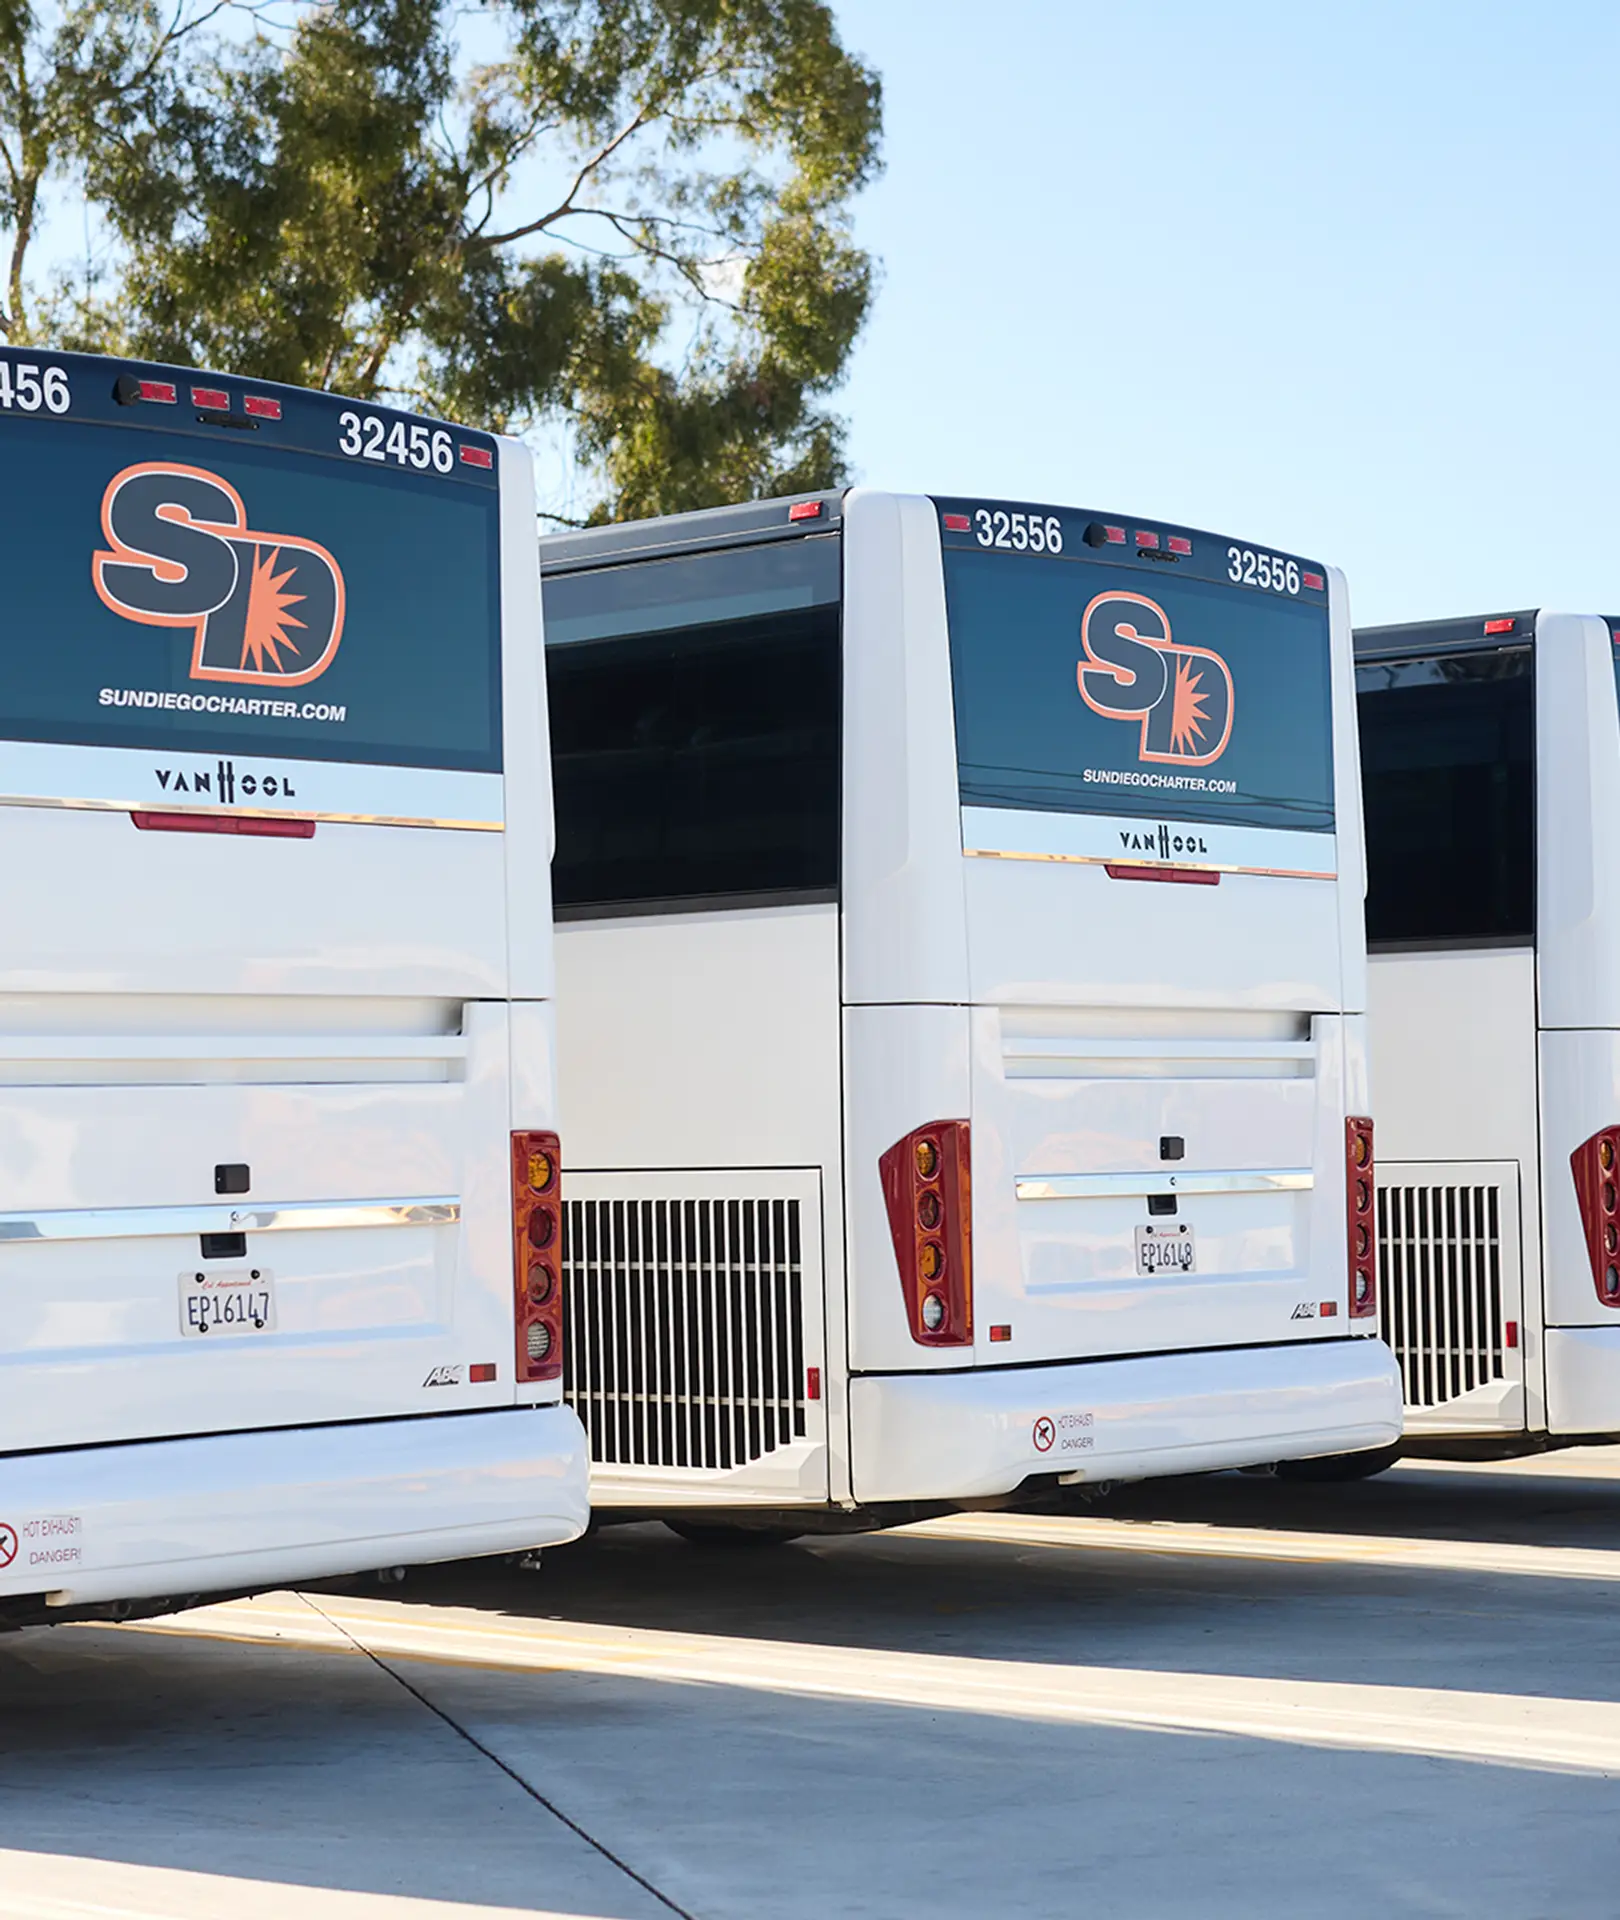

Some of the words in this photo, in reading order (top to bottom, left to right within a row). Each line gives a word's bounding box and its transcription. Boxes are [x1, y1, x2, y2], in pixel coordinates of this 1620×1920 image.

[338, 411, 454, 473] 32456
[974, 508, 1063, 554] 32556
[1226, 546, 1300, 595] 32556
[98, 687, 347, 722] SUNDIEGOCHARTER.COM
[1082, 768, 1237, 793] SUNDIEGOCHARTER.COM
[1141, 1242, 1193, 1267] EP16148
[187, 1292, 269, 1326] EP16147
